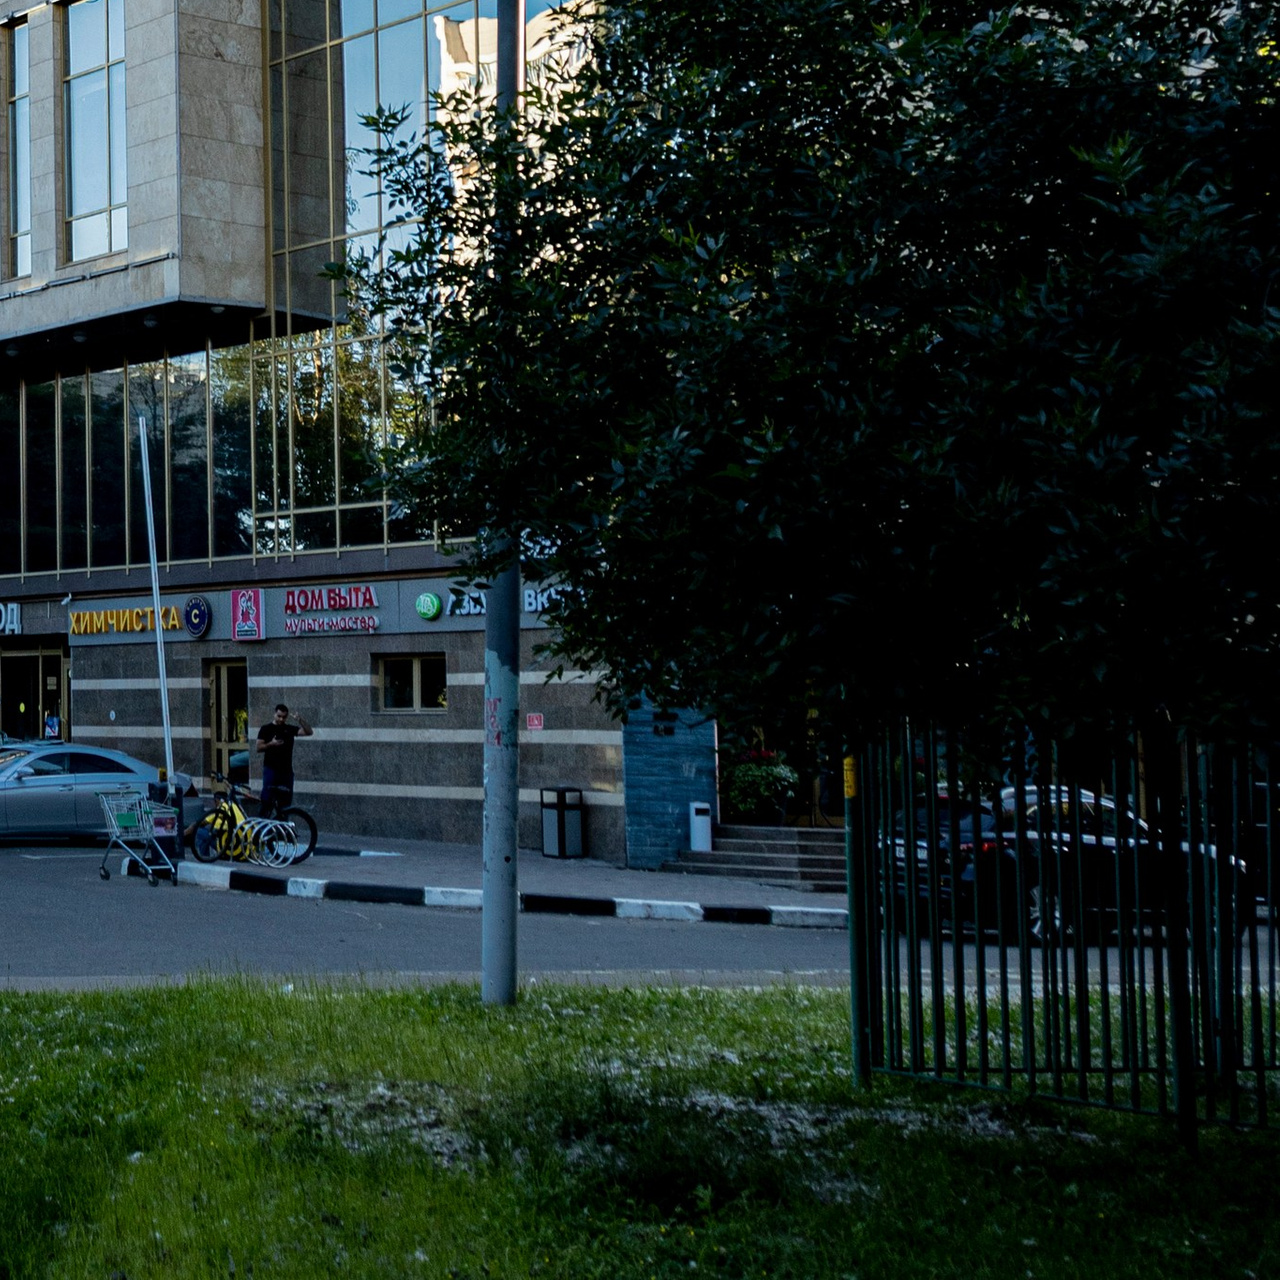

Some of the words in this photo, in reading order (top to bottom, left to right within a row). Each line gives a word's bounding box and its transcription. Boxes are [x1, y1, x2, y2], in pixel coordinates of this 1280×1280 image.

[285, 589, 326, 614] ДОМ
[327, 586, 377, 610] БЫТА
[69, 606, 182, 635] ХИМЧИСТКА
[285, 615, 378, 635] мульти-мастер
